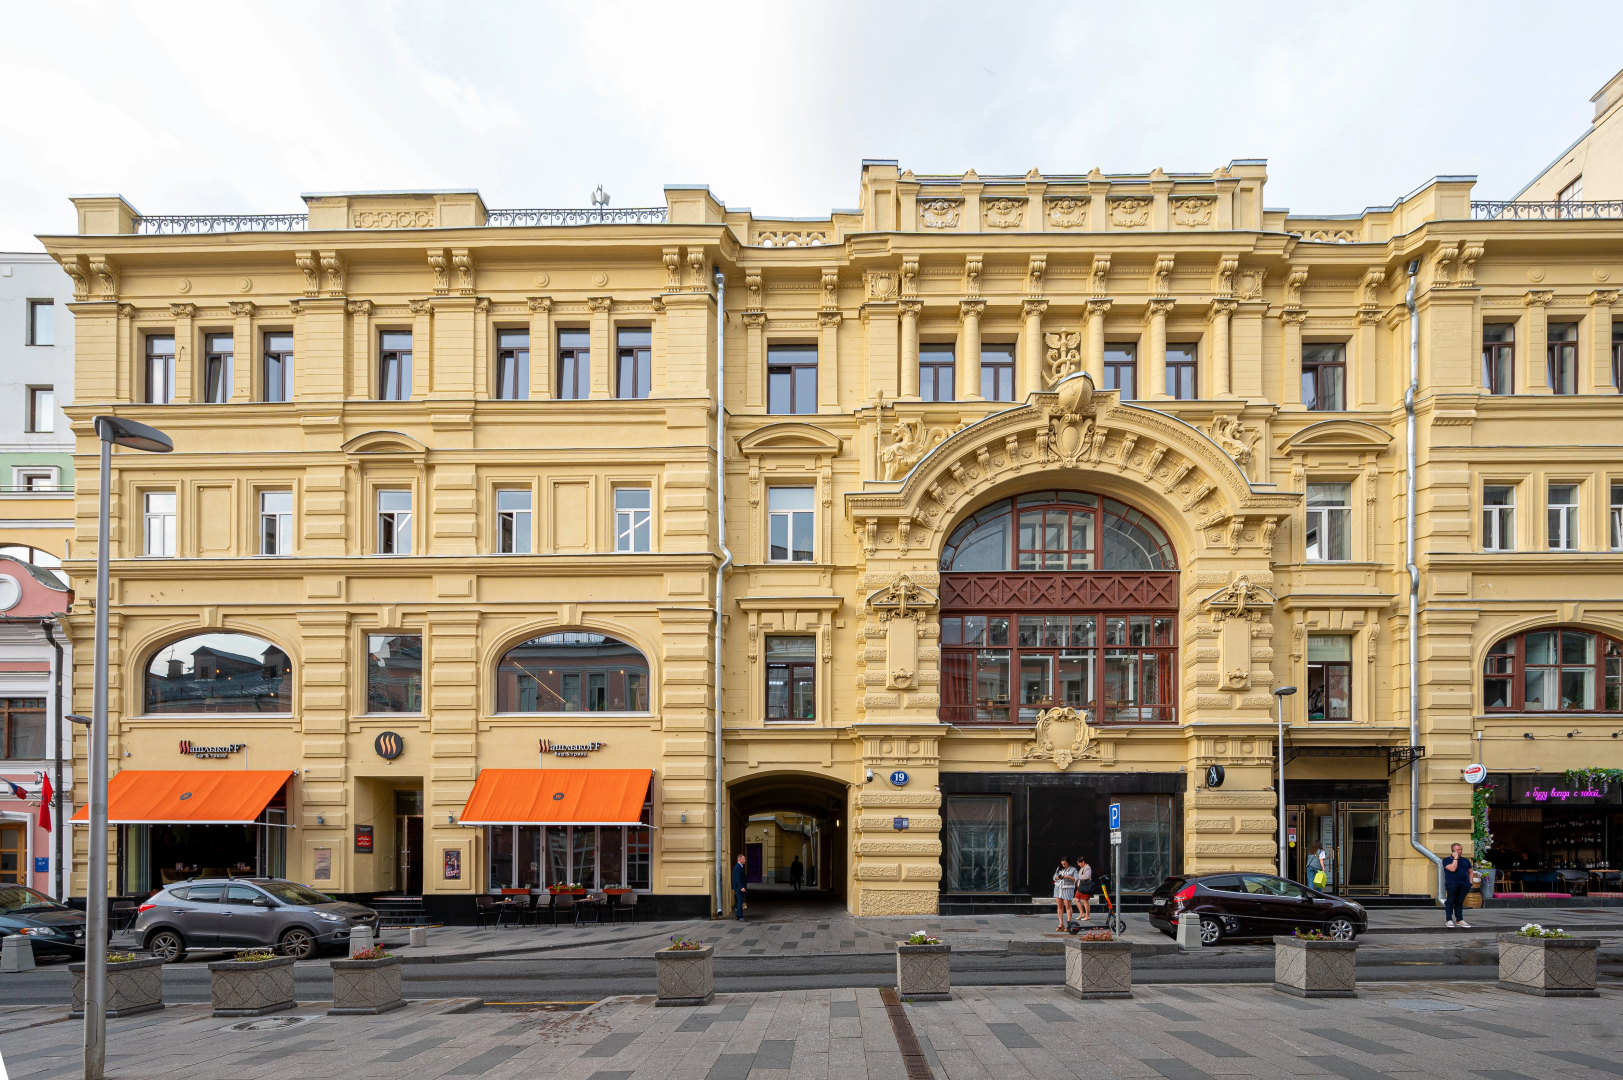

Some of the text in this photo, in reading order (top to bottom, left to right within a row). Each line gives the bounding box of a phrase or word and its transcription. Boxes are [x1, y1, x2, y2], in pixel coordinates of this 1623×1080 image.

[895, 773, 905, 781] 19
[1533, 787, 1548, 800] буду
[1551, 788, 1570, 800] всегда
[1112, 808, 1118, 826] P
